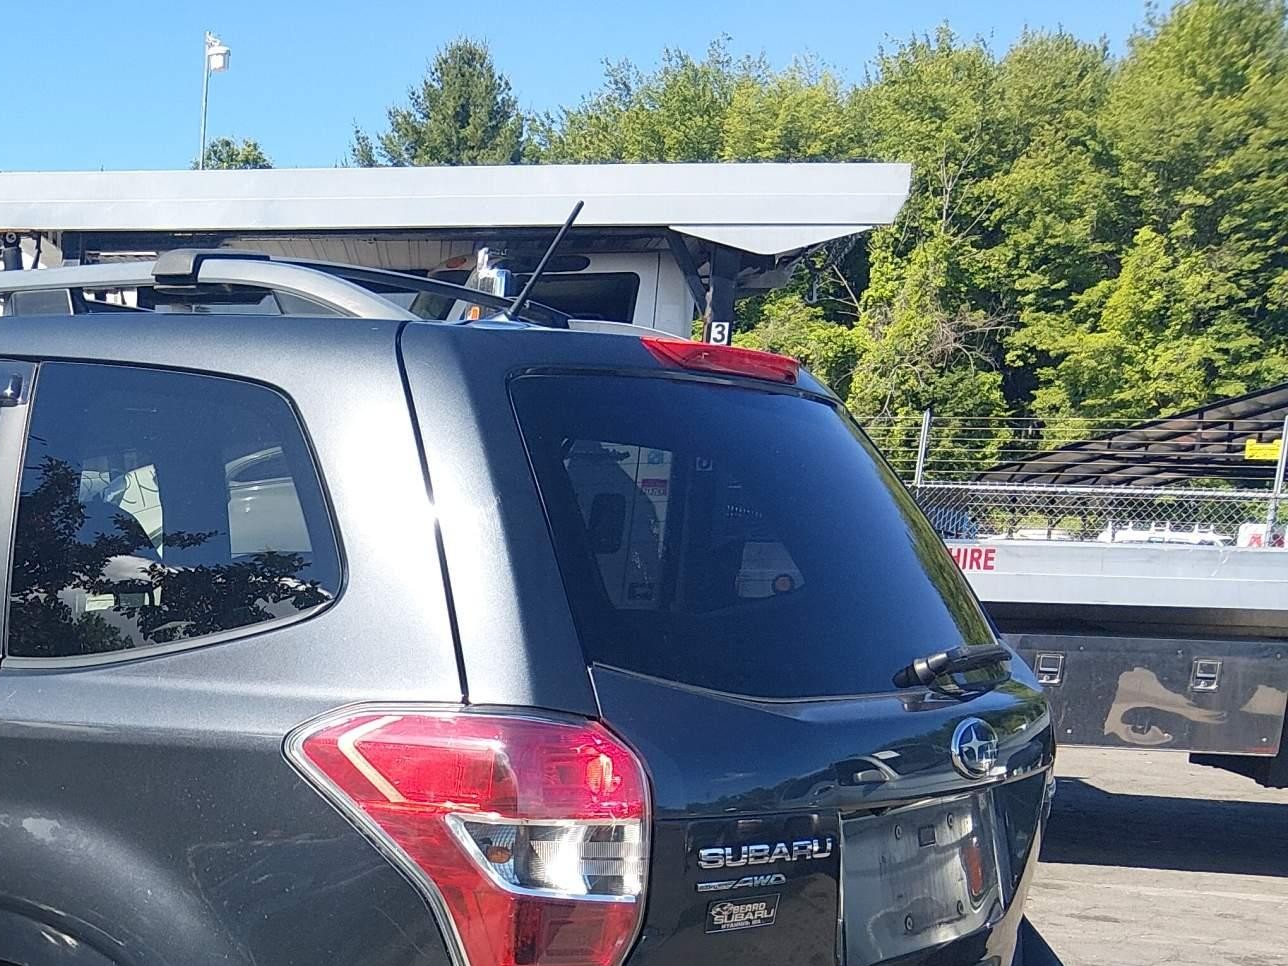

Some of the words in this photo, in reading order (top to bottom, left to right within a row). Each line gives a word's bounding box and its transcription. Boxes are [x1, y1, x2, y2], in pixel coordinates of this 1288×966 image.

[713, 324, 726, 343] 3
[698, 838, 832, 869] SUBARU
[734, 873, 786, 889] AWD
[714, 908, 774, 925] SUBARU
